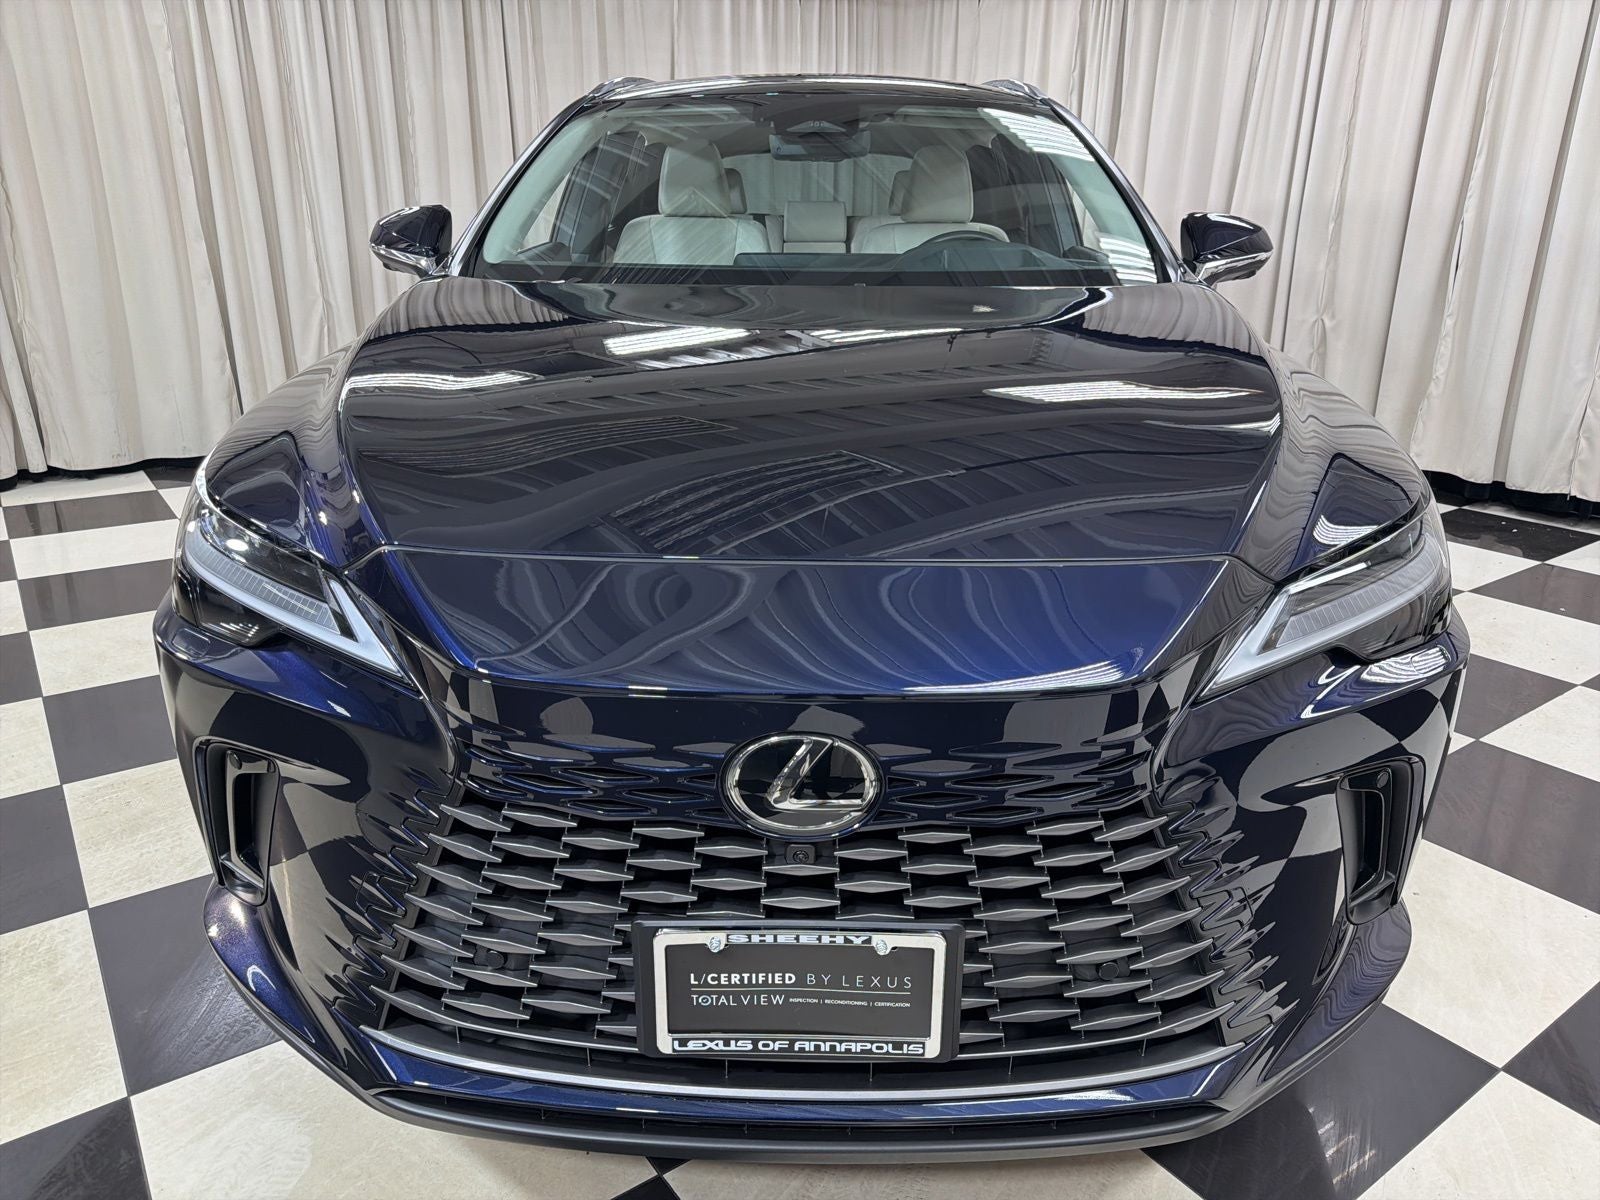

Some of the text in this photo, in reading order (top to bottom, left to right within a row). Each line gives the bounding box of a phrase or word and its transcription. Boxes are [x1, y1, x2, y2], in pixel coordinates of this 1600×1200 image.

[727, 934, 870, 945] SHEEHY
[690, 973, 912, 989] L/CERTIFIED BY LEXUS
[691, 995, 738, 1006] TOTAL
[741, 994, 785, 1006] VIEW
[673, 1040, 924, 1054] LEXUS OF ANNAPOLIS
